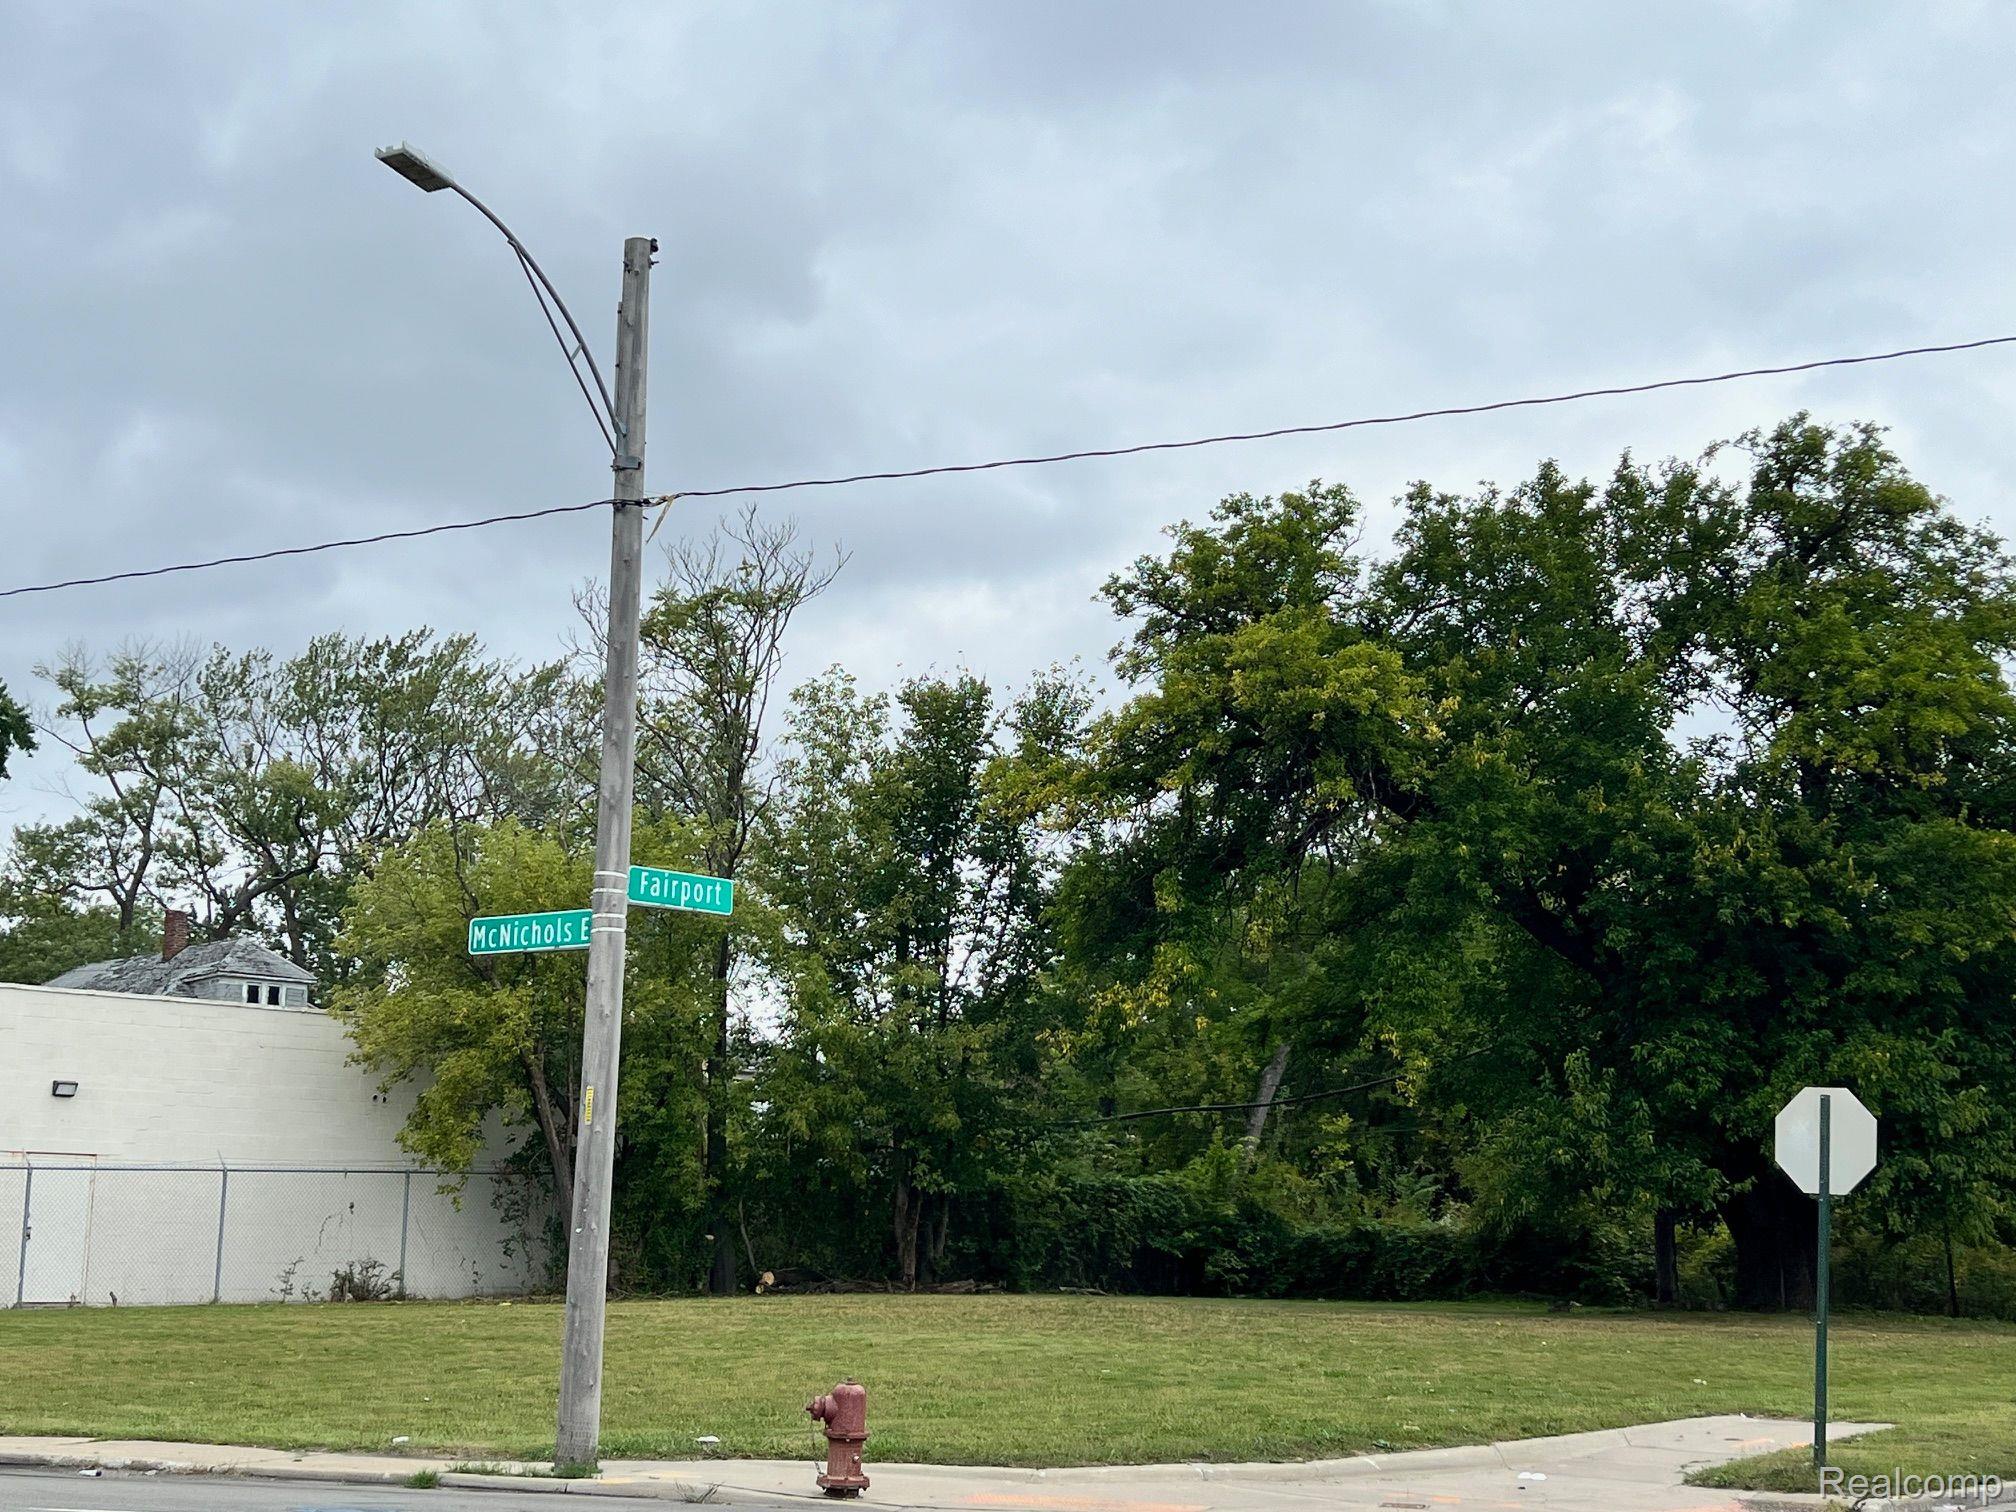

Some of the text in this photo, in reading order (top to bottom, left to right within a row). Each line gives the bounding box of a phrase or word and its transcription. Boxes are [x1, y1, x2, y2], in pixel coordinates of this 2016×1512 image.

[639, 871, 722, 907] Fairport
[472, 916, 590, 949] McNichols E
